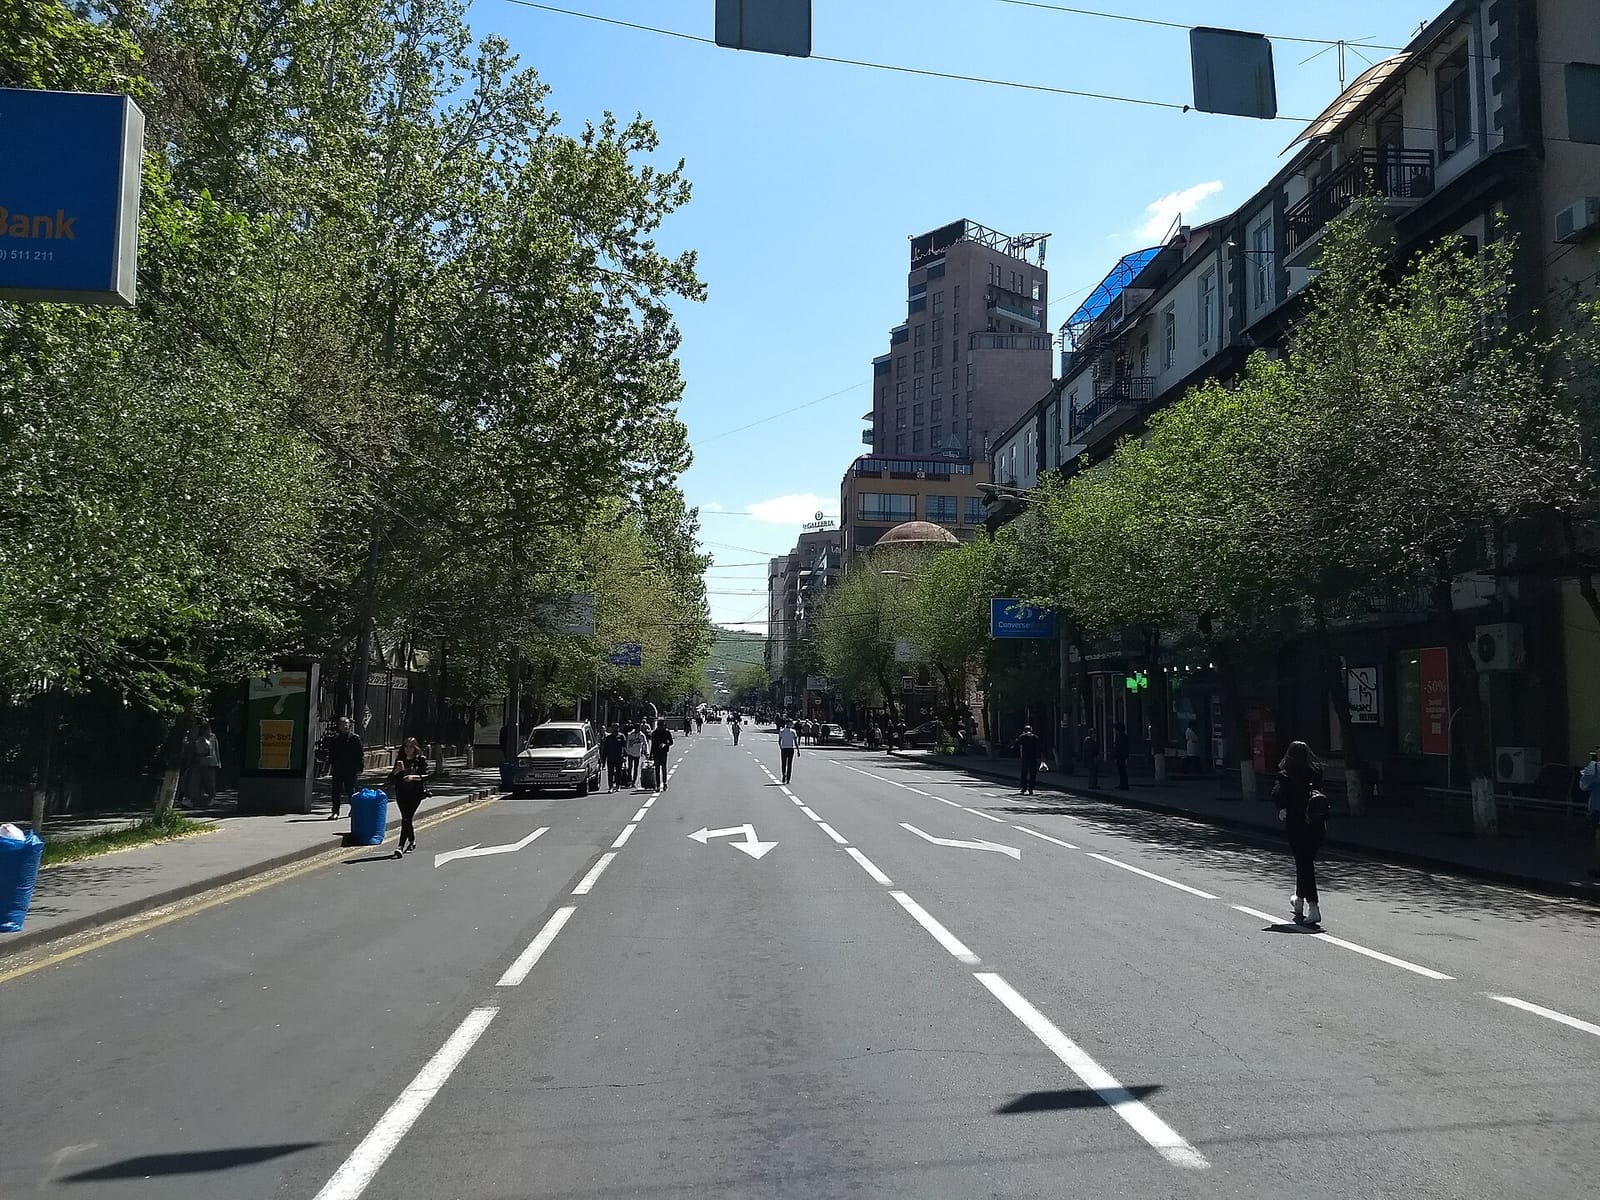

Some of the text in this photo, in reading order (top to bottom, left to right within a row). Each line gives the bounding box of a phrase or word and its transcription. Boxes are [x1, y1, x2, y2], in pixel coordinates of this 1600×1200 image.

[11, 250, 29, 260] 511
[34, 251, 53, 261] 211
[998, 621, 1031, 629] Converse
